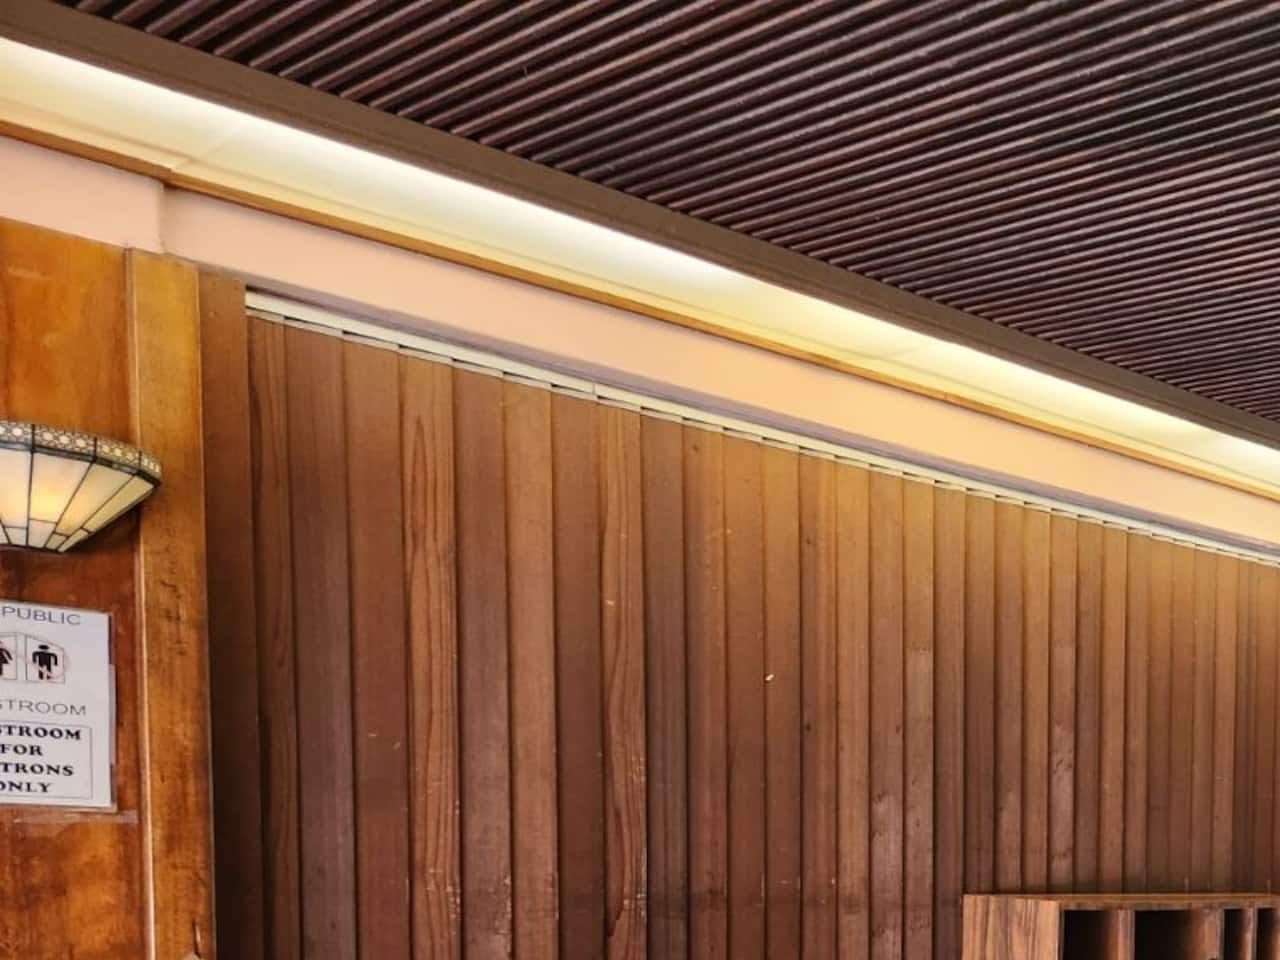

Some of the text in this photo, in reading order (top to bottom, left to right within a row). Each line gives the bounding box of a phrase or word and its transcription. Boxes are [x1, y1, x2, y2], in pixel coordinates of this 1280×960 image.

[1, 606, 81, 626] PUBLIC
[0, 698, 86, 716] TROOM
[0, 724, 81, 741] TROOM
[0, 743, 43, 757] FOR
